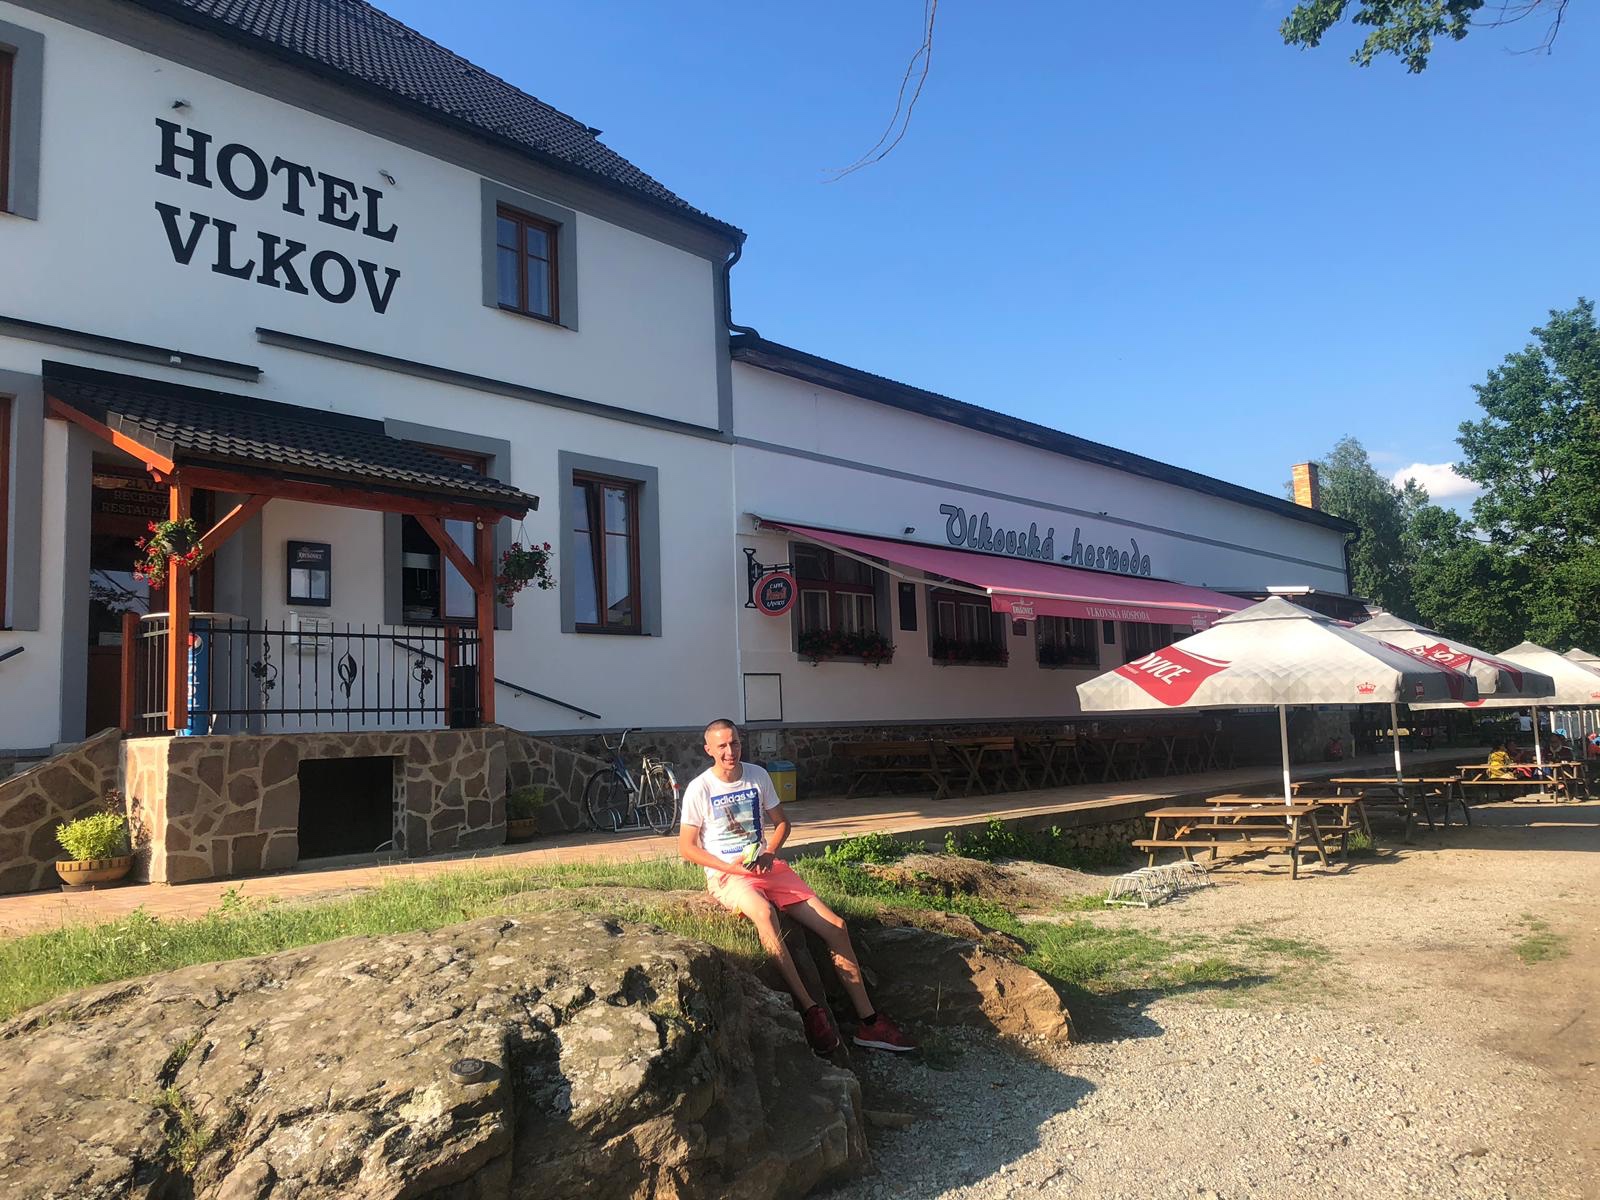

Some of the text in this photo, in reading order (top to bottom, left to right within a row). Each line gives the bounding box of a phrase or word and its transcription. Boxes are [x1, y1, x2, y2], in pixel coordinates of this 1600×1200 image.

[155, 118, 398, 242] HOTEL
[155, 201, 401, 315] VLKOV
[102, 502, 168, 515] RESTAUR
[939, 503, 1151, 576] Vlkovská hospoda
[713, 792, 746, 807] adidas
